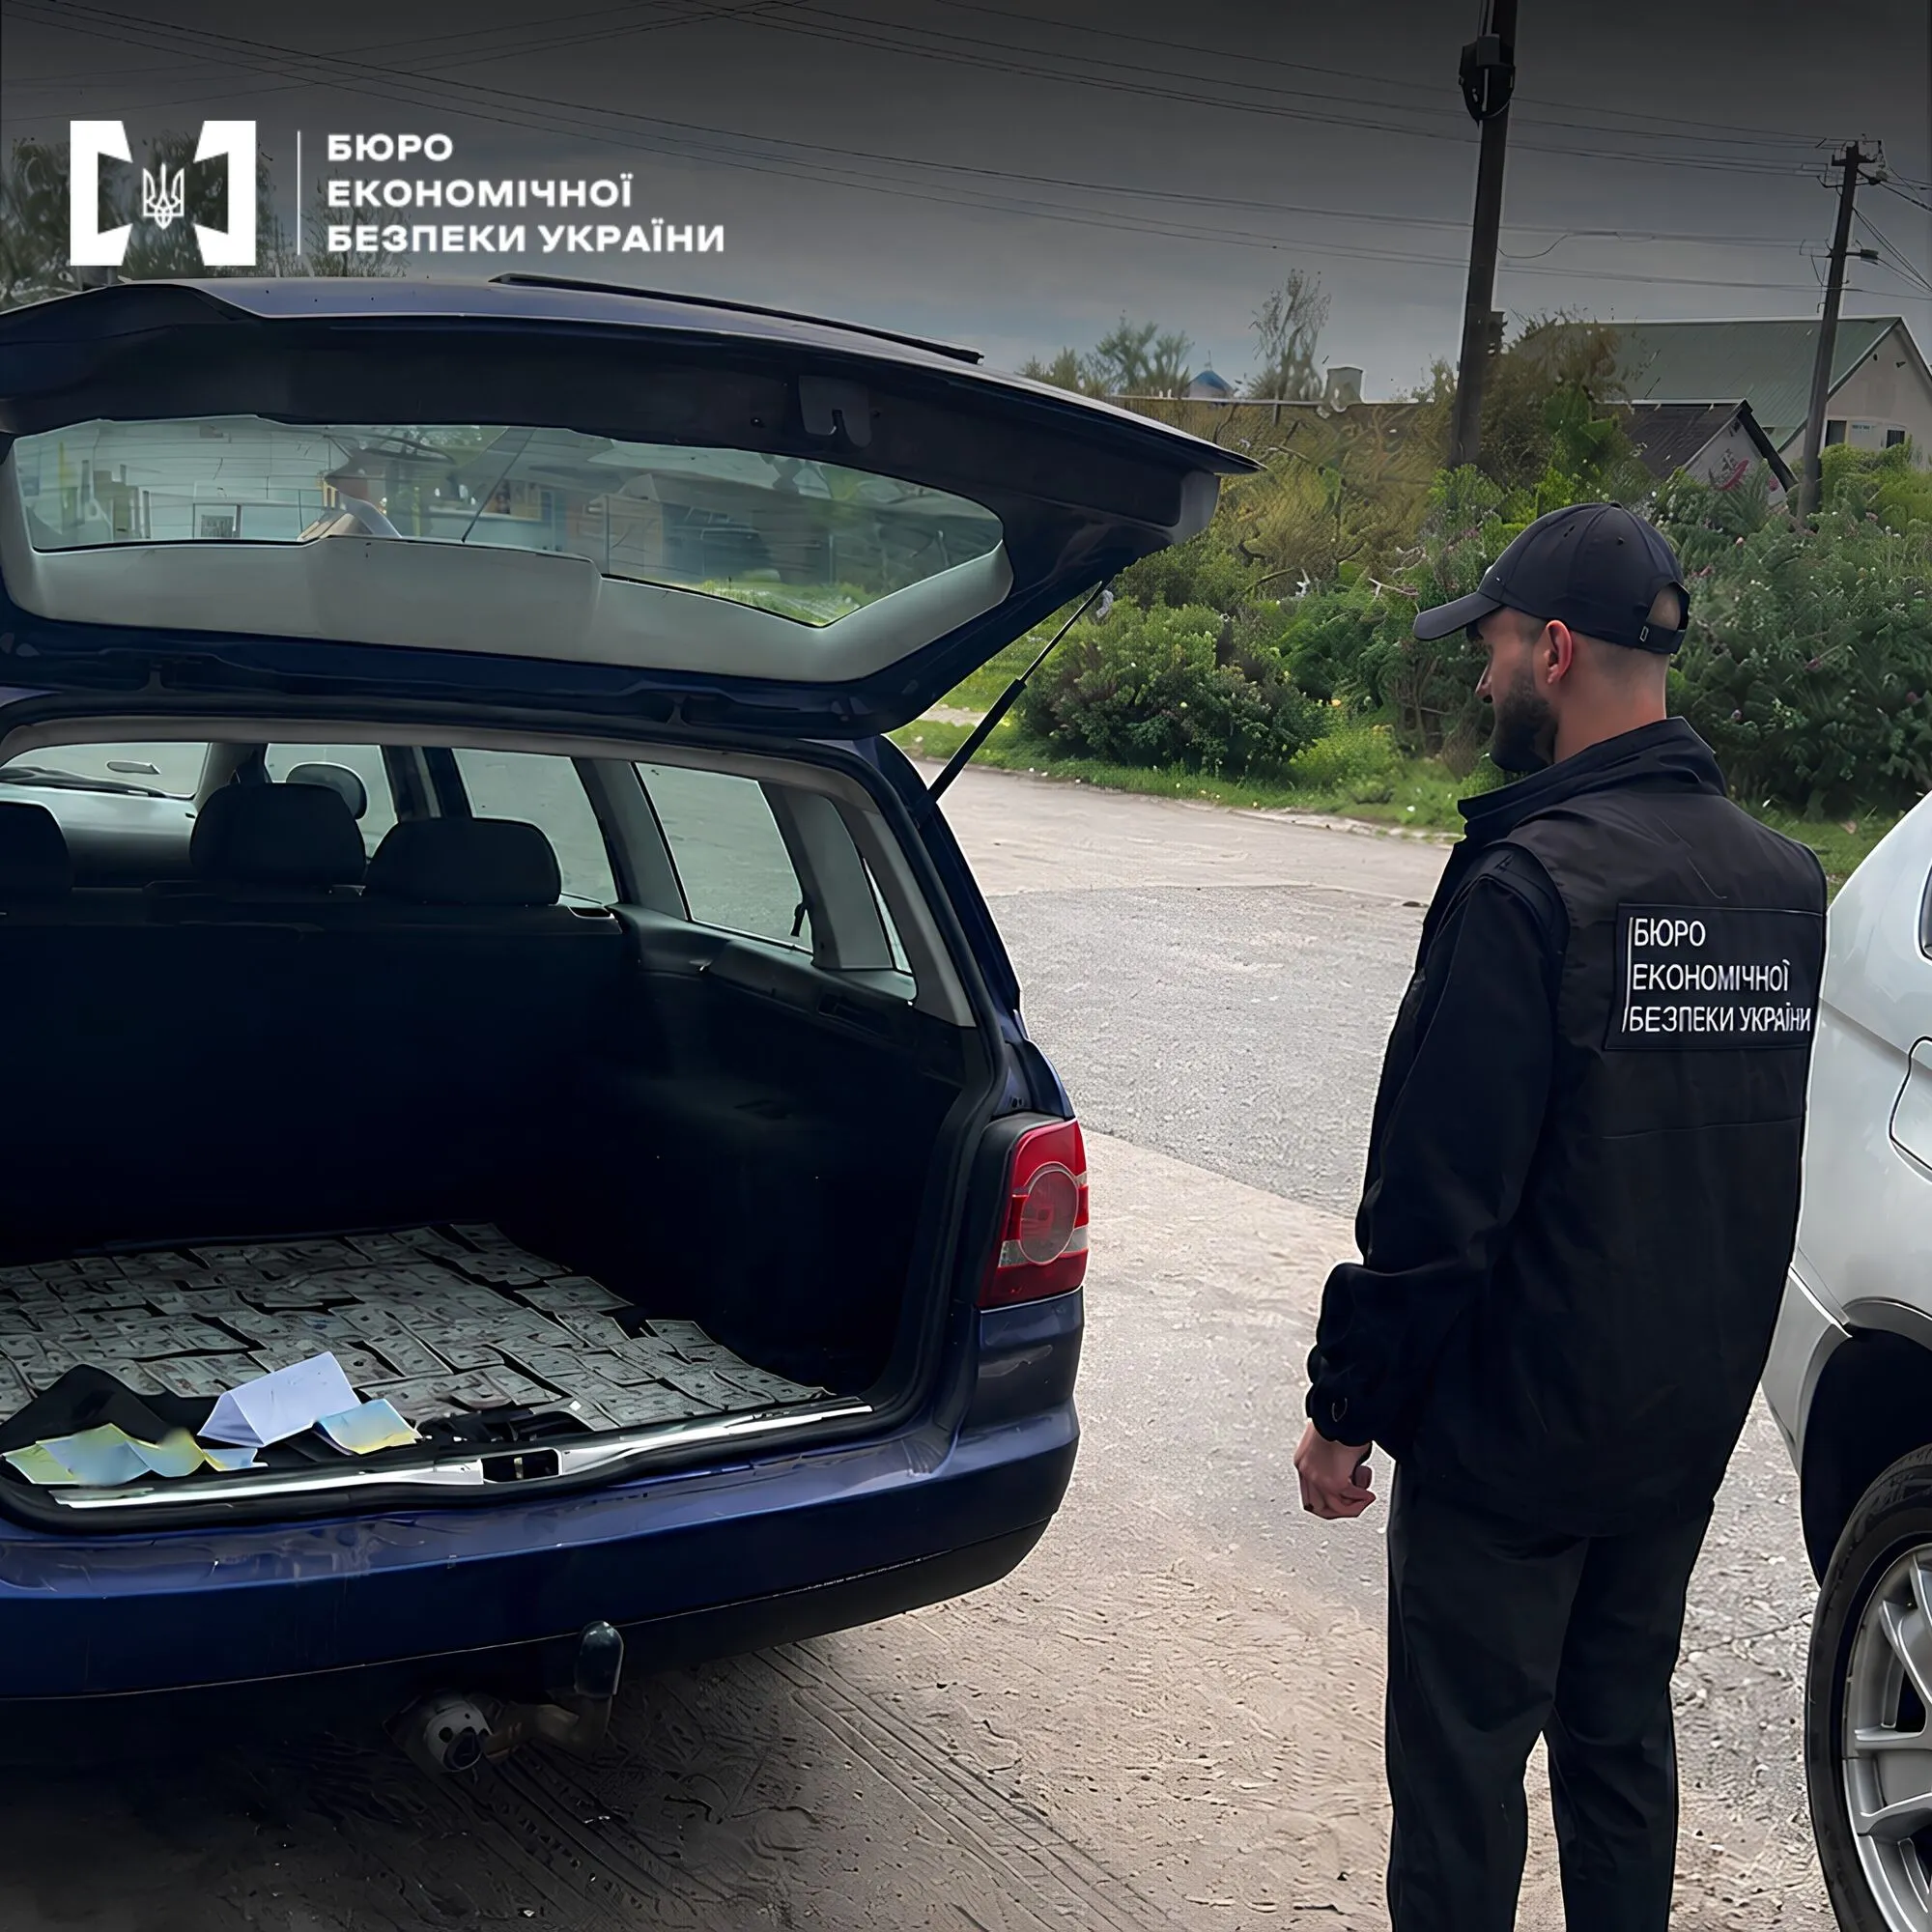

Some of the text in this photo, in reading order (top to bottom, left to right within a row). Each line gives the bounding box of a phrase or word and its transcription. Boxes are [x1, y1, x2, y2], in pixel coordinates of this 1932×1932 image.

[1634, 918, 1706, 947] БЮРО
[1632, 958, 1790, 991] ЕКОНОМІЧНОЇ
[1629, 1002, 1811, 1032] БЕЗПЕКИ УКРАЇНИ
